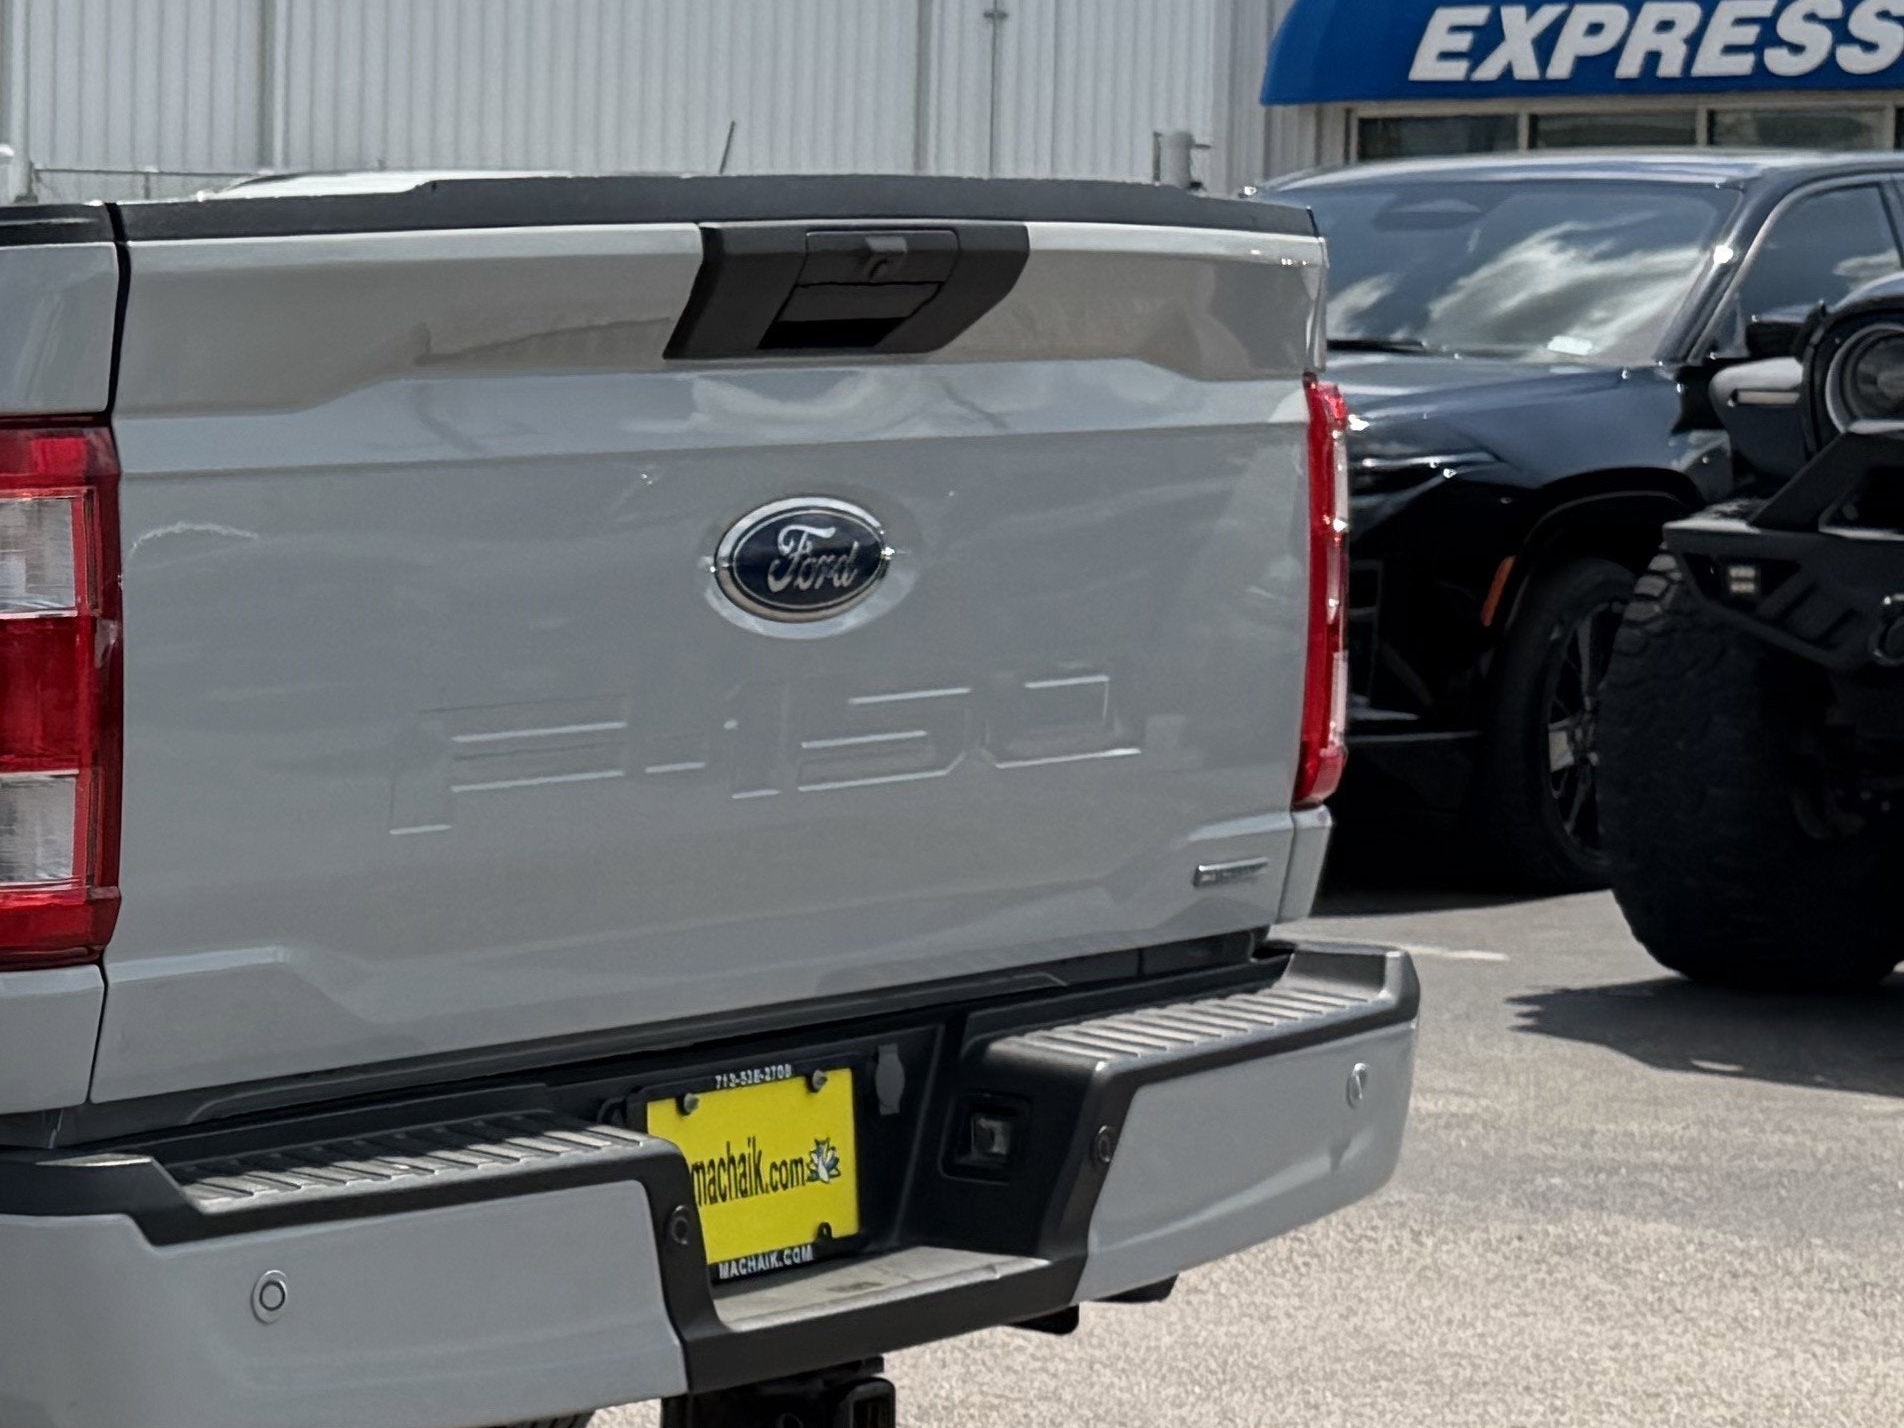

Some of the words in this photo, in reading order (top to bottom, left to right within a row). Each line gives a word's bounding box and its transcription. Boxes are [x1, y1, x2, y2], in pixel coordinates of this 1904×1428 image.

[768, 523, 860, 593] Ford
[691, 1136, 807, 1206] machaik.com
[718, 1244, 814, 1280] MACHAIK.COM
